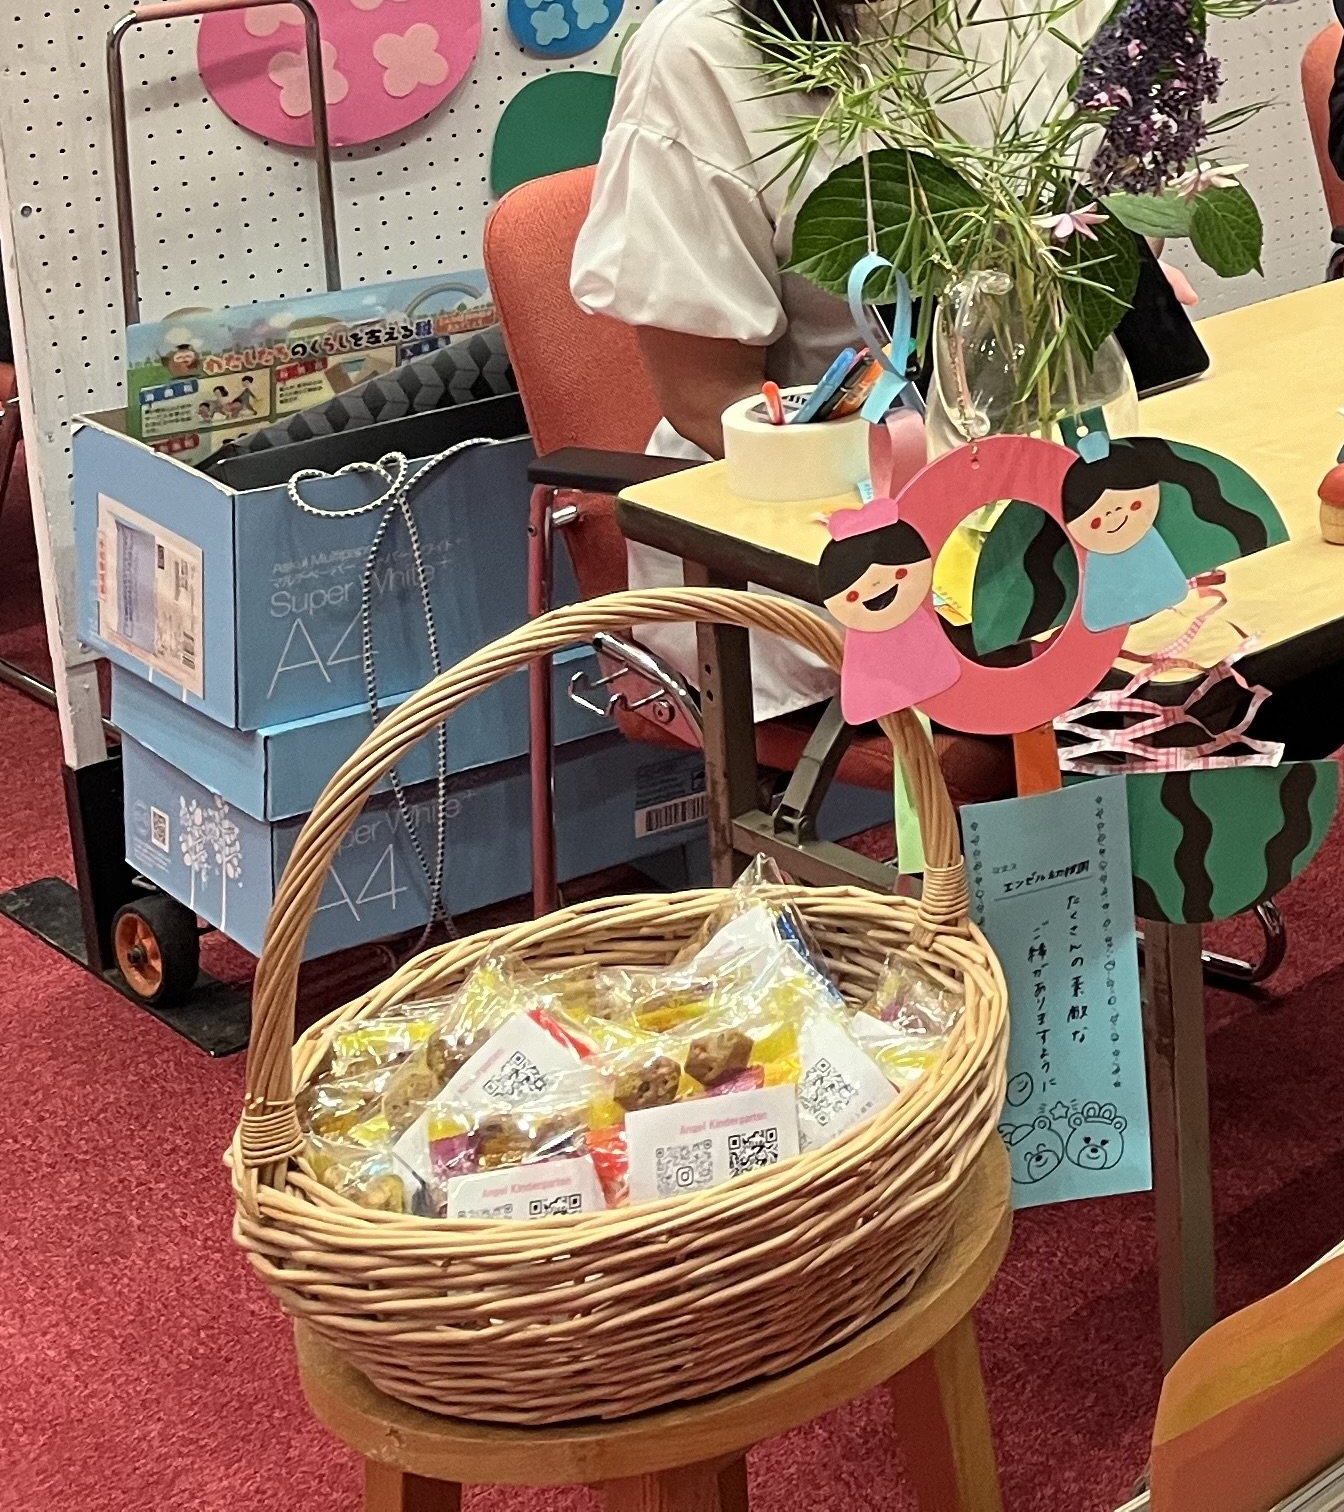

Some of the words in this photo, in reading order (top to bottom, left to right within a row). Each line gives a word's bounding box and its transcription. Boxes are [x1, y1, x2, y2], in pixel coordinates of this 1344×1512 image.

[270, 581, 353, 618] Super
[267, 605, 379, 700] A4
[1066, 894, 1088, 1043] たくさんの素敵な
[708, 1110, 768, 1131] Kindergarten
